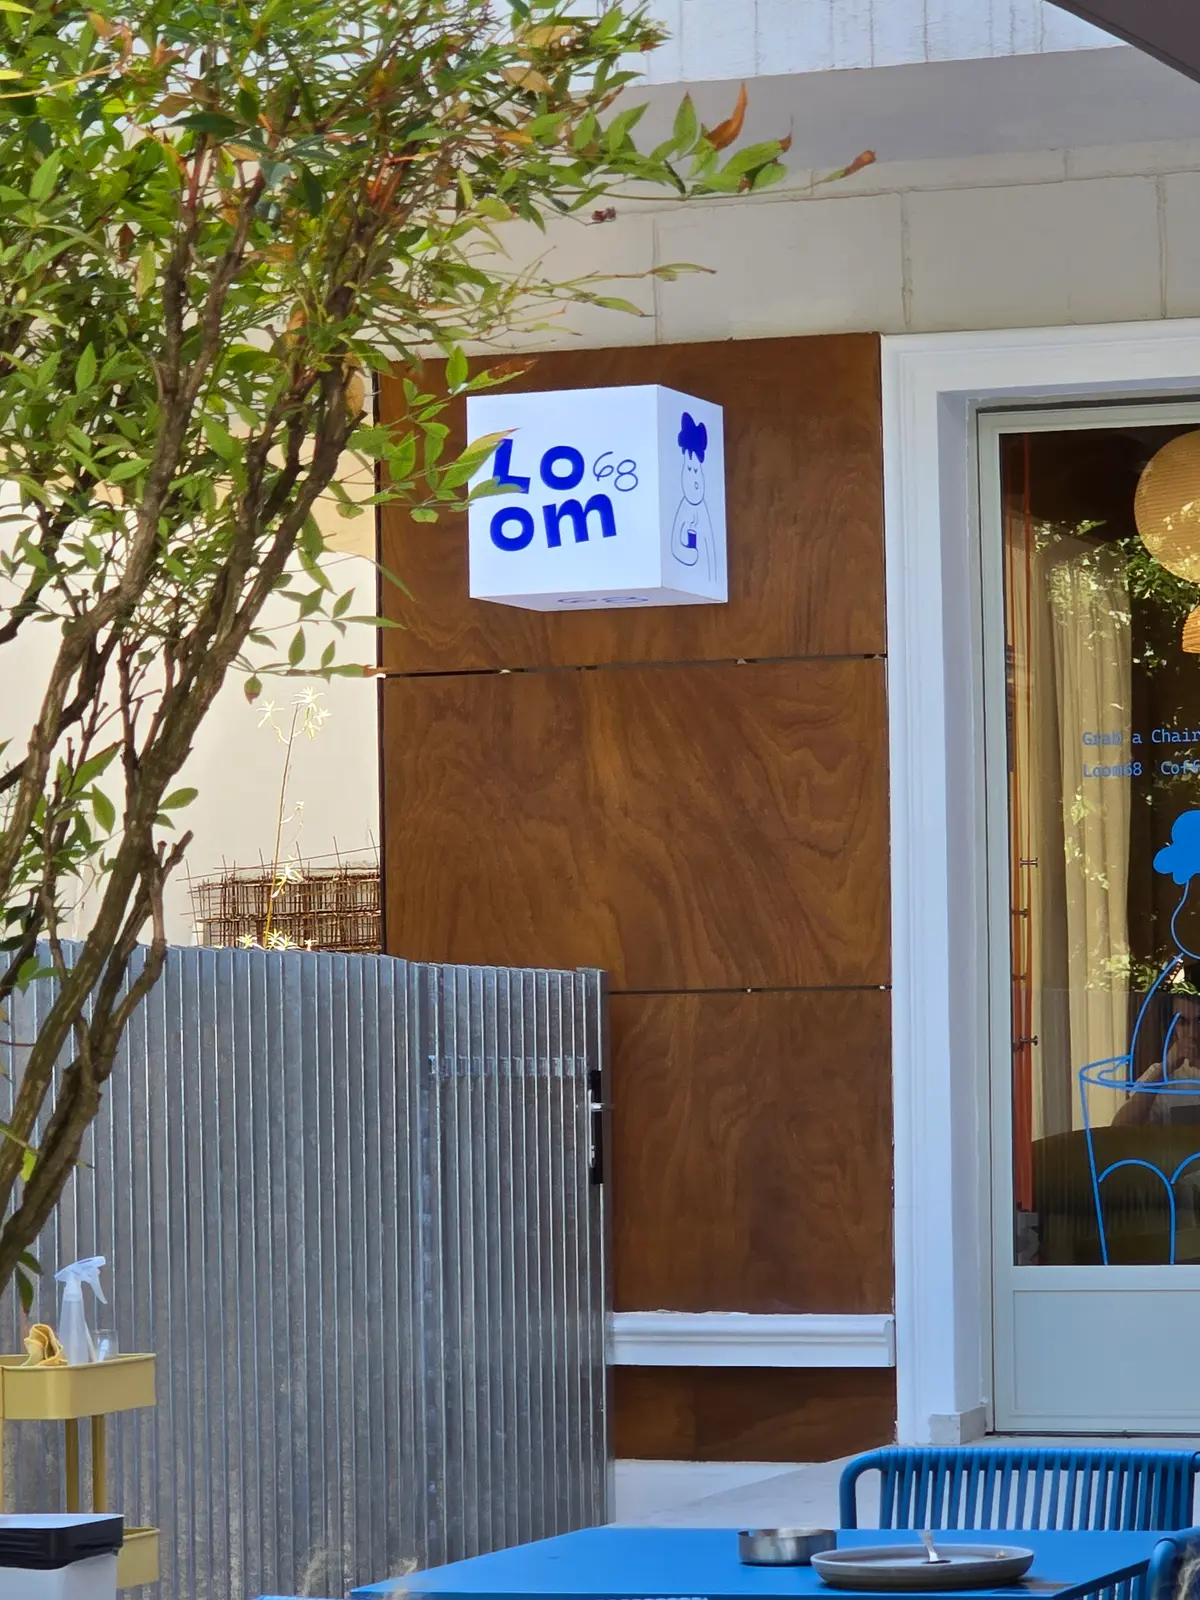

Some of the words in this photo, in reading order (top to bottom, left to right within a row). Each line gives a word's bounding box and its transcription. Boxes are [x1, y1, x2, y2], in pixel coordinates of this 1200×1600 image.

[593, 451, 639, 492] 68
[489, 494, 617, 551] om
[1082, 731, 1123, 746] Grab
[1132, 733, 1142, 744] a
[1151, 727, 1200, 743] Chair
[1083, 762, 1142, 777] Loom68
